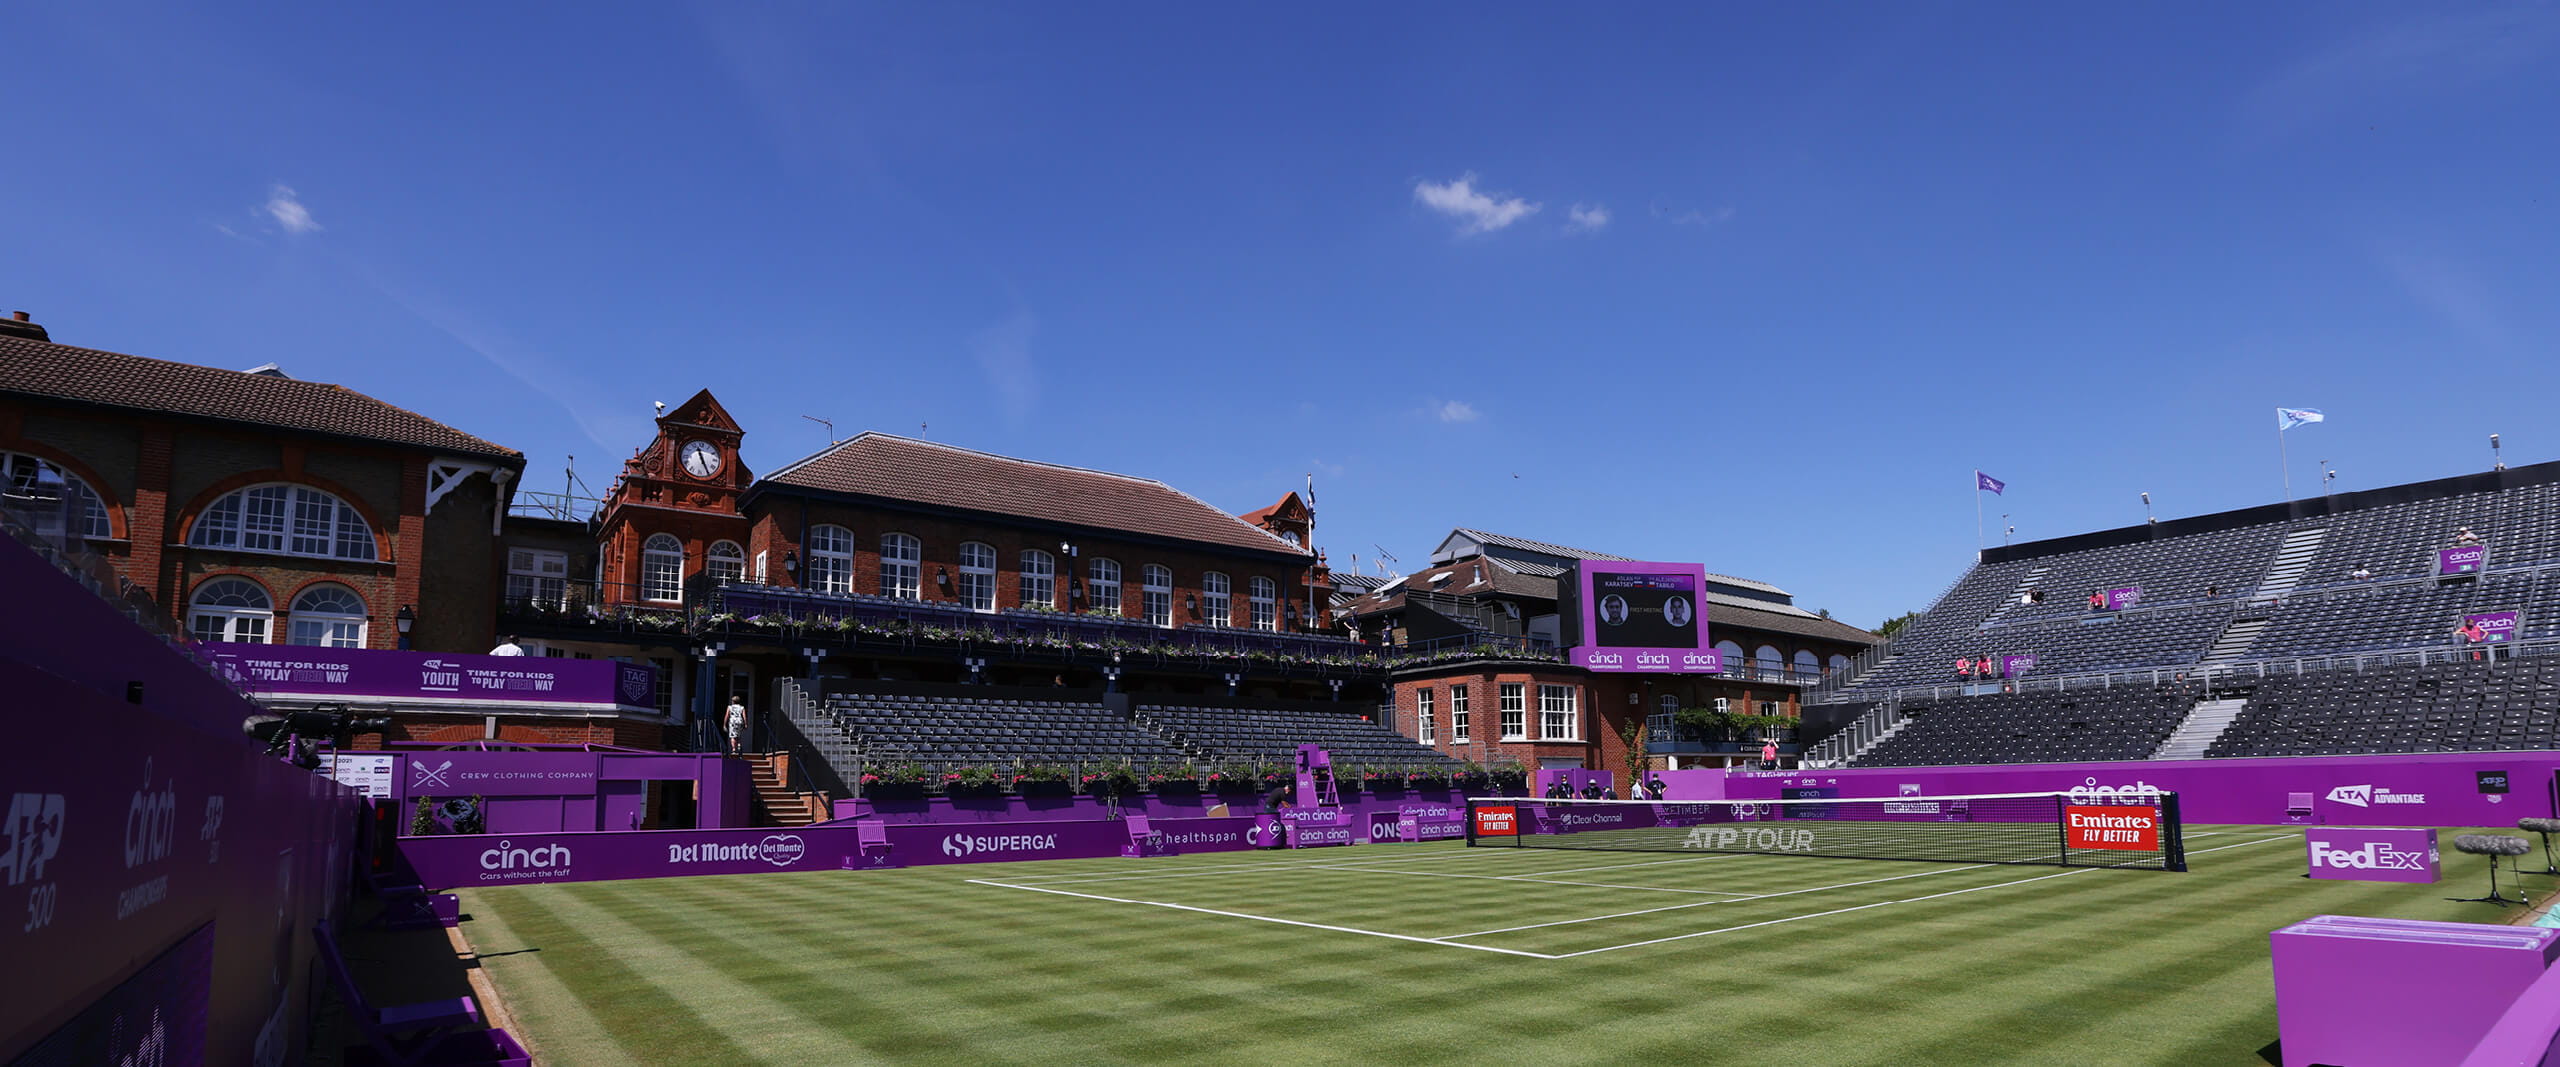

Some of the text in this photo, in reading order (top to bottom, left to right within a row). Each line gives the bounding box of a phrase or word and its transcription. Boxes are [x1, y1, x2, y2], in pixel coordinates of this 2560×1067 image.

[2449, 551, 2480, 560] cinch
[1589, 651, 1622, 664] cinch
[1636, 651, 1670, 664] cinch
[1683, 652, 1716, 665] cinch
[245, 659, 349, 671] TIME FOR KIDS
[264, 669, 290, 681] PLAY
[326, 672, 349, 683] WAY
[422, 671, 459, 686] YOUTH
[467, 669, 555, 680] TIME FOR KIDS
[625, 671, 646, 682] TAG
[472, 677, 482, 685] TO
[482, 678, 505, 689] PLAY
[535, 680, 554, 691] WAY
[461, 772, 489, 780] CREW
[547, 771, 594, 779] COMPANY
[2069, 777, 2161, 806] cinch
[2374, 793, 2426, 804] ADVANTAGE
[125, 756, 175, 869] cinch
[1312, 809, 1336, 820] cinch
[1428, 806, 1448, 817] cinch
[1478, 811, 1514, 821] Emirates
[1572, 813, 1622, 825] Clear Channel
[2070, 813, 2152, 829] Emirates
[1300, 828, 1349, 841] cinch cinch
[1421, 822, 1462, 835] cinch cinch
[0, 792, 65, 886] ATP
[1166, 831, 1237, 845] healthspan
[1680, 828, 1816, 851] ATP TOUR
[2083, 829, 2140, 843] FLY BETTER
[763, 843, 802, 853] Del Monte
[976, 834, 1056, 852] SUPERGA
[480, 840, 571, 870] cinch
[668, 842, 758, 863] Del Monte
[2310, 841, 2425, 871] FedEx
[480, 869, 571, 880] Cars without the faff
[25, 882, 57, 934] 500
